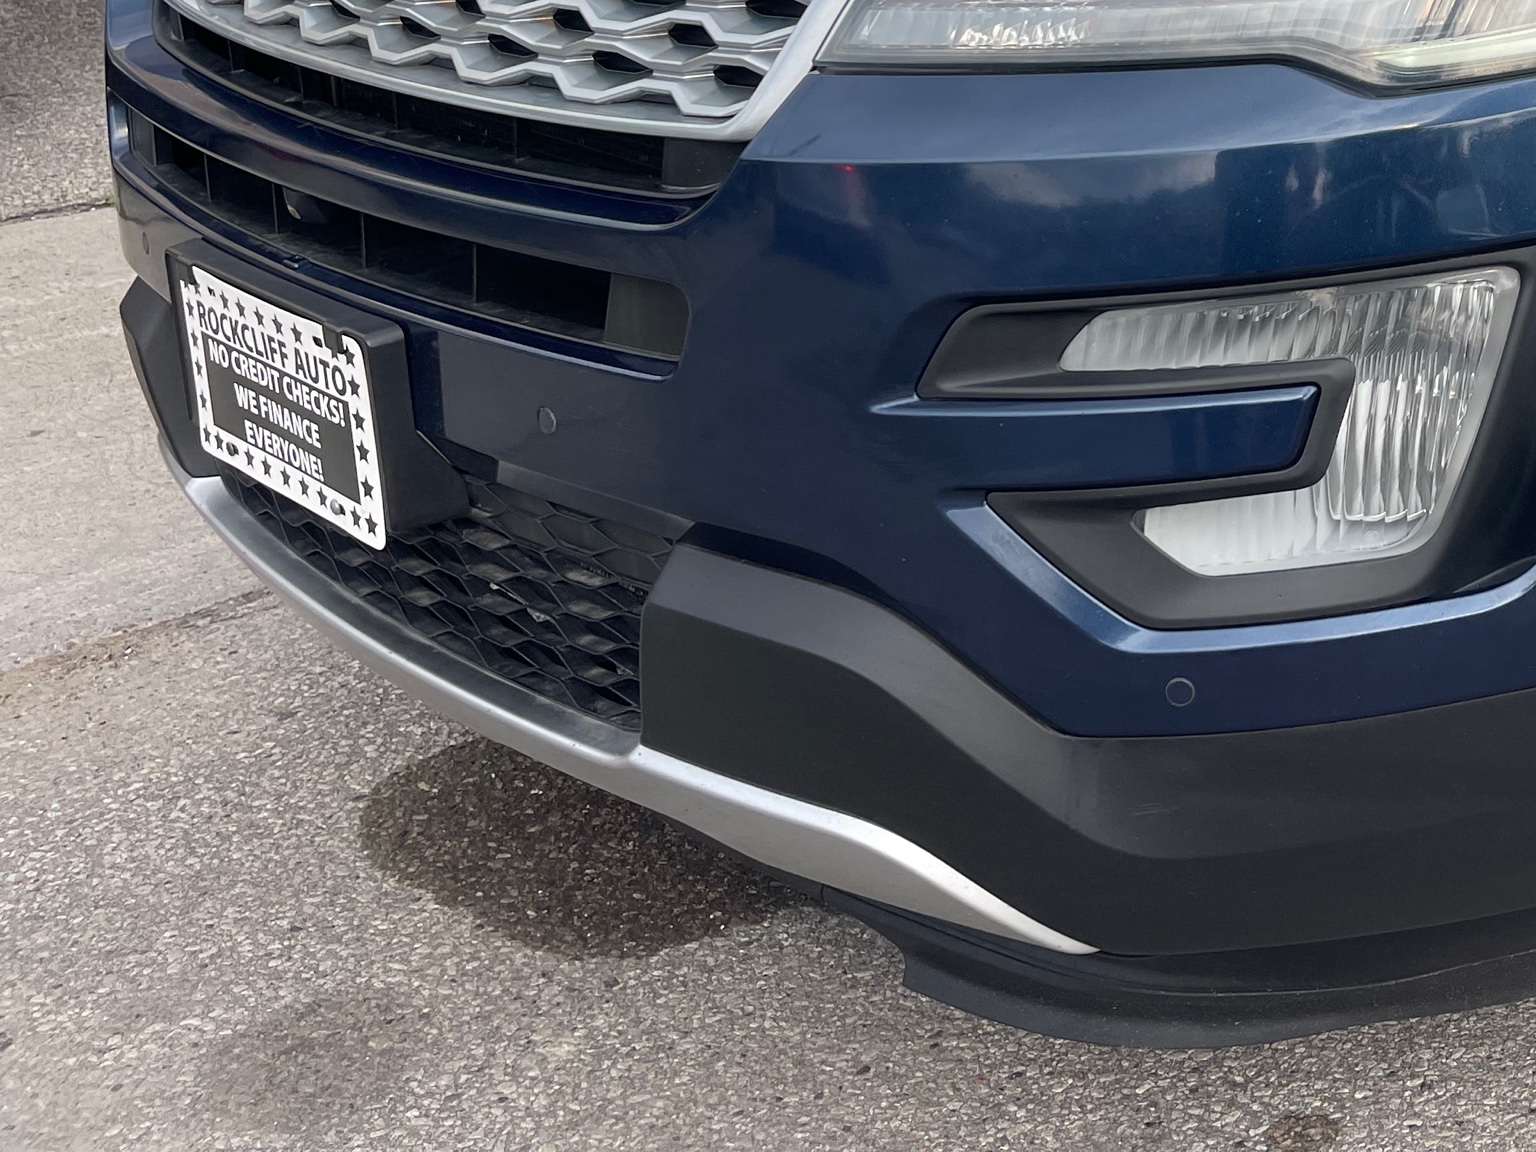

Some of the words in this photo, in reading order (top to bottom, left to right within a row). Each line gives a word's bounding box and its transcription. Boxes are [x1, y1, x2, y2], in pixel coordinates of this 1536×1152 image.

[196, 300, 290, 369] ROCKCLIFF
[294, 348, 347, 397] AUTO
[207, 338, 229, 368] NO
[231, 351, 280, 394] CREDIT
[283, 380, 346, 428] CHECKS!
[234, 383, 259, 415] WE
[260, 395, 322, 449] FINANCE
[244, 419, 324, 482] EVERYONE!
